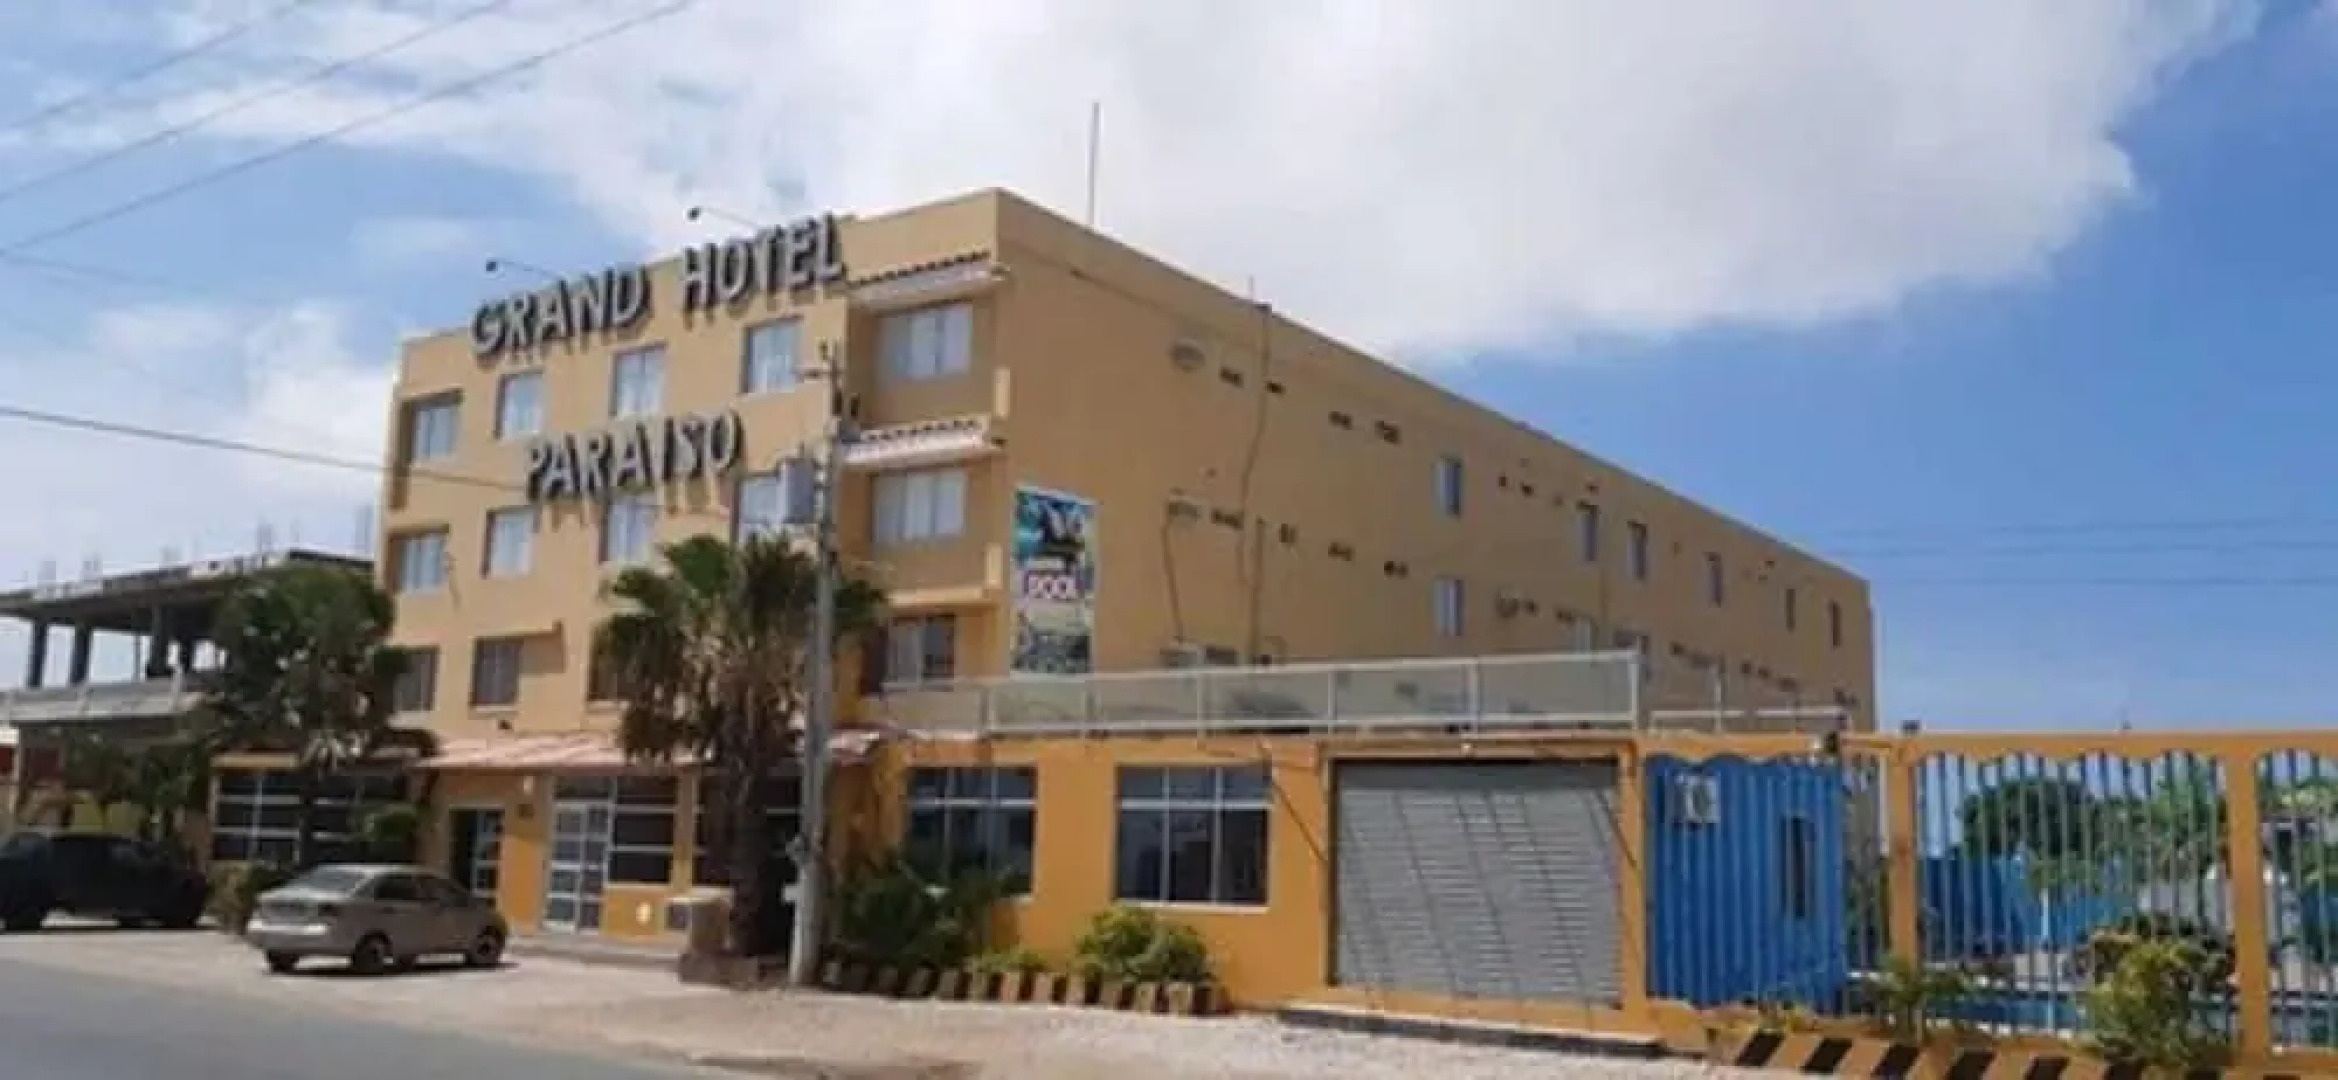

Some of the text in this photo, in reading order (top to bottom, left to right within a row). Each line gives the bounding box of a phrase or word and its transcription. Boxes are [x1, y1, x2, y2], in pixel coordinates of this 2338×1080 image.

[471, 212, 846, 358] GRAND HOTEL
[526, 411, 743, 500] PARAISO
